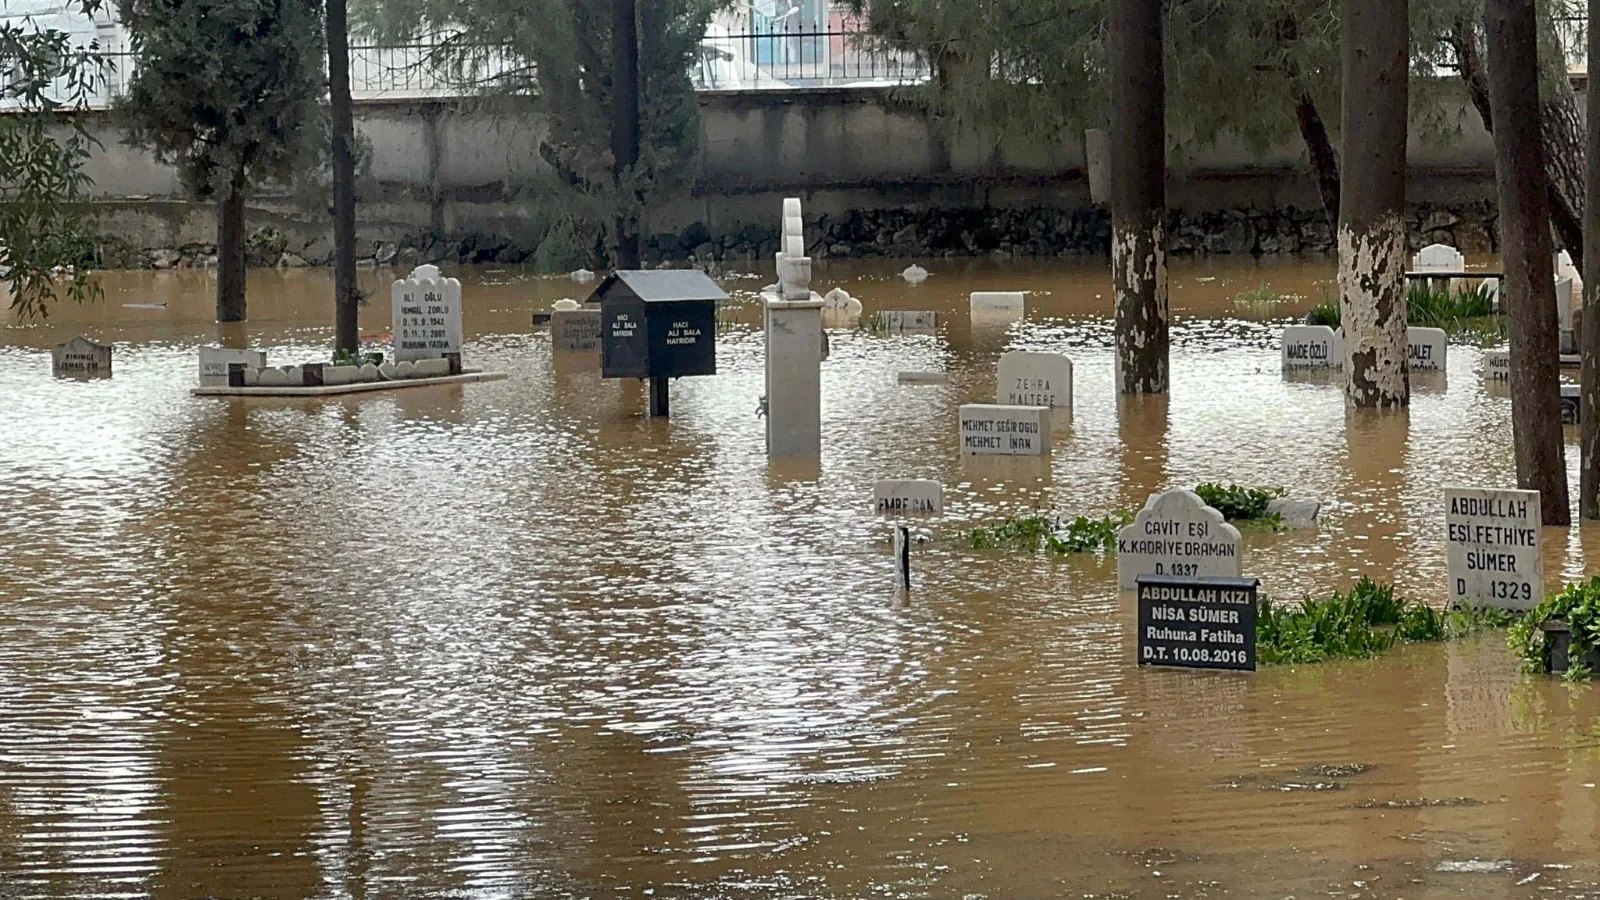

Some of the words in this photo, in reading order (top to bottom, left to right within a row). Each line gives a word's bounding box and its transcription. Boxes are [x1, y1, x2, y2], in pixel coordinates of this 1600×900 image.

[1287, 340, 1308, 359] MAİDE
[1309, 340, 1327, 359] ÖZLÜ
[1408, 344, 1432, 360] DALET
[1017, 378, 1050, 390] ZEHRA
[962, 420, 994, 431] MEHMET
[965, 436, 1001, 448] MEHMET
[1009, 434, 1031, 449] İNAN
[1451, 497, 1527, 518] ABDULLAH
[1145, 519, 1181, 537] CAVİT
[1188, 521, 1209, 539] EŞİ
[1172, 563, 1198, 576] 1337
[1467, 549, 1516, 572] SÜMER
[1142, 587, 1217, 603] ABDULLAH
[1220, 590, 1250, 604] KIZI
[1491, 580, 1532, 600] 1329
[1152, 603, 1186, 621] NİSA
[1189, 606, 1239, 624] SÜMER
[1147, 626, 1197, 642] Ruhuna
[1200, 629, 1244, 644] Fatiha
[1143, 646, 1169, 660] D.T.
[1173, 648, 1247, 664] 10.08.2016
